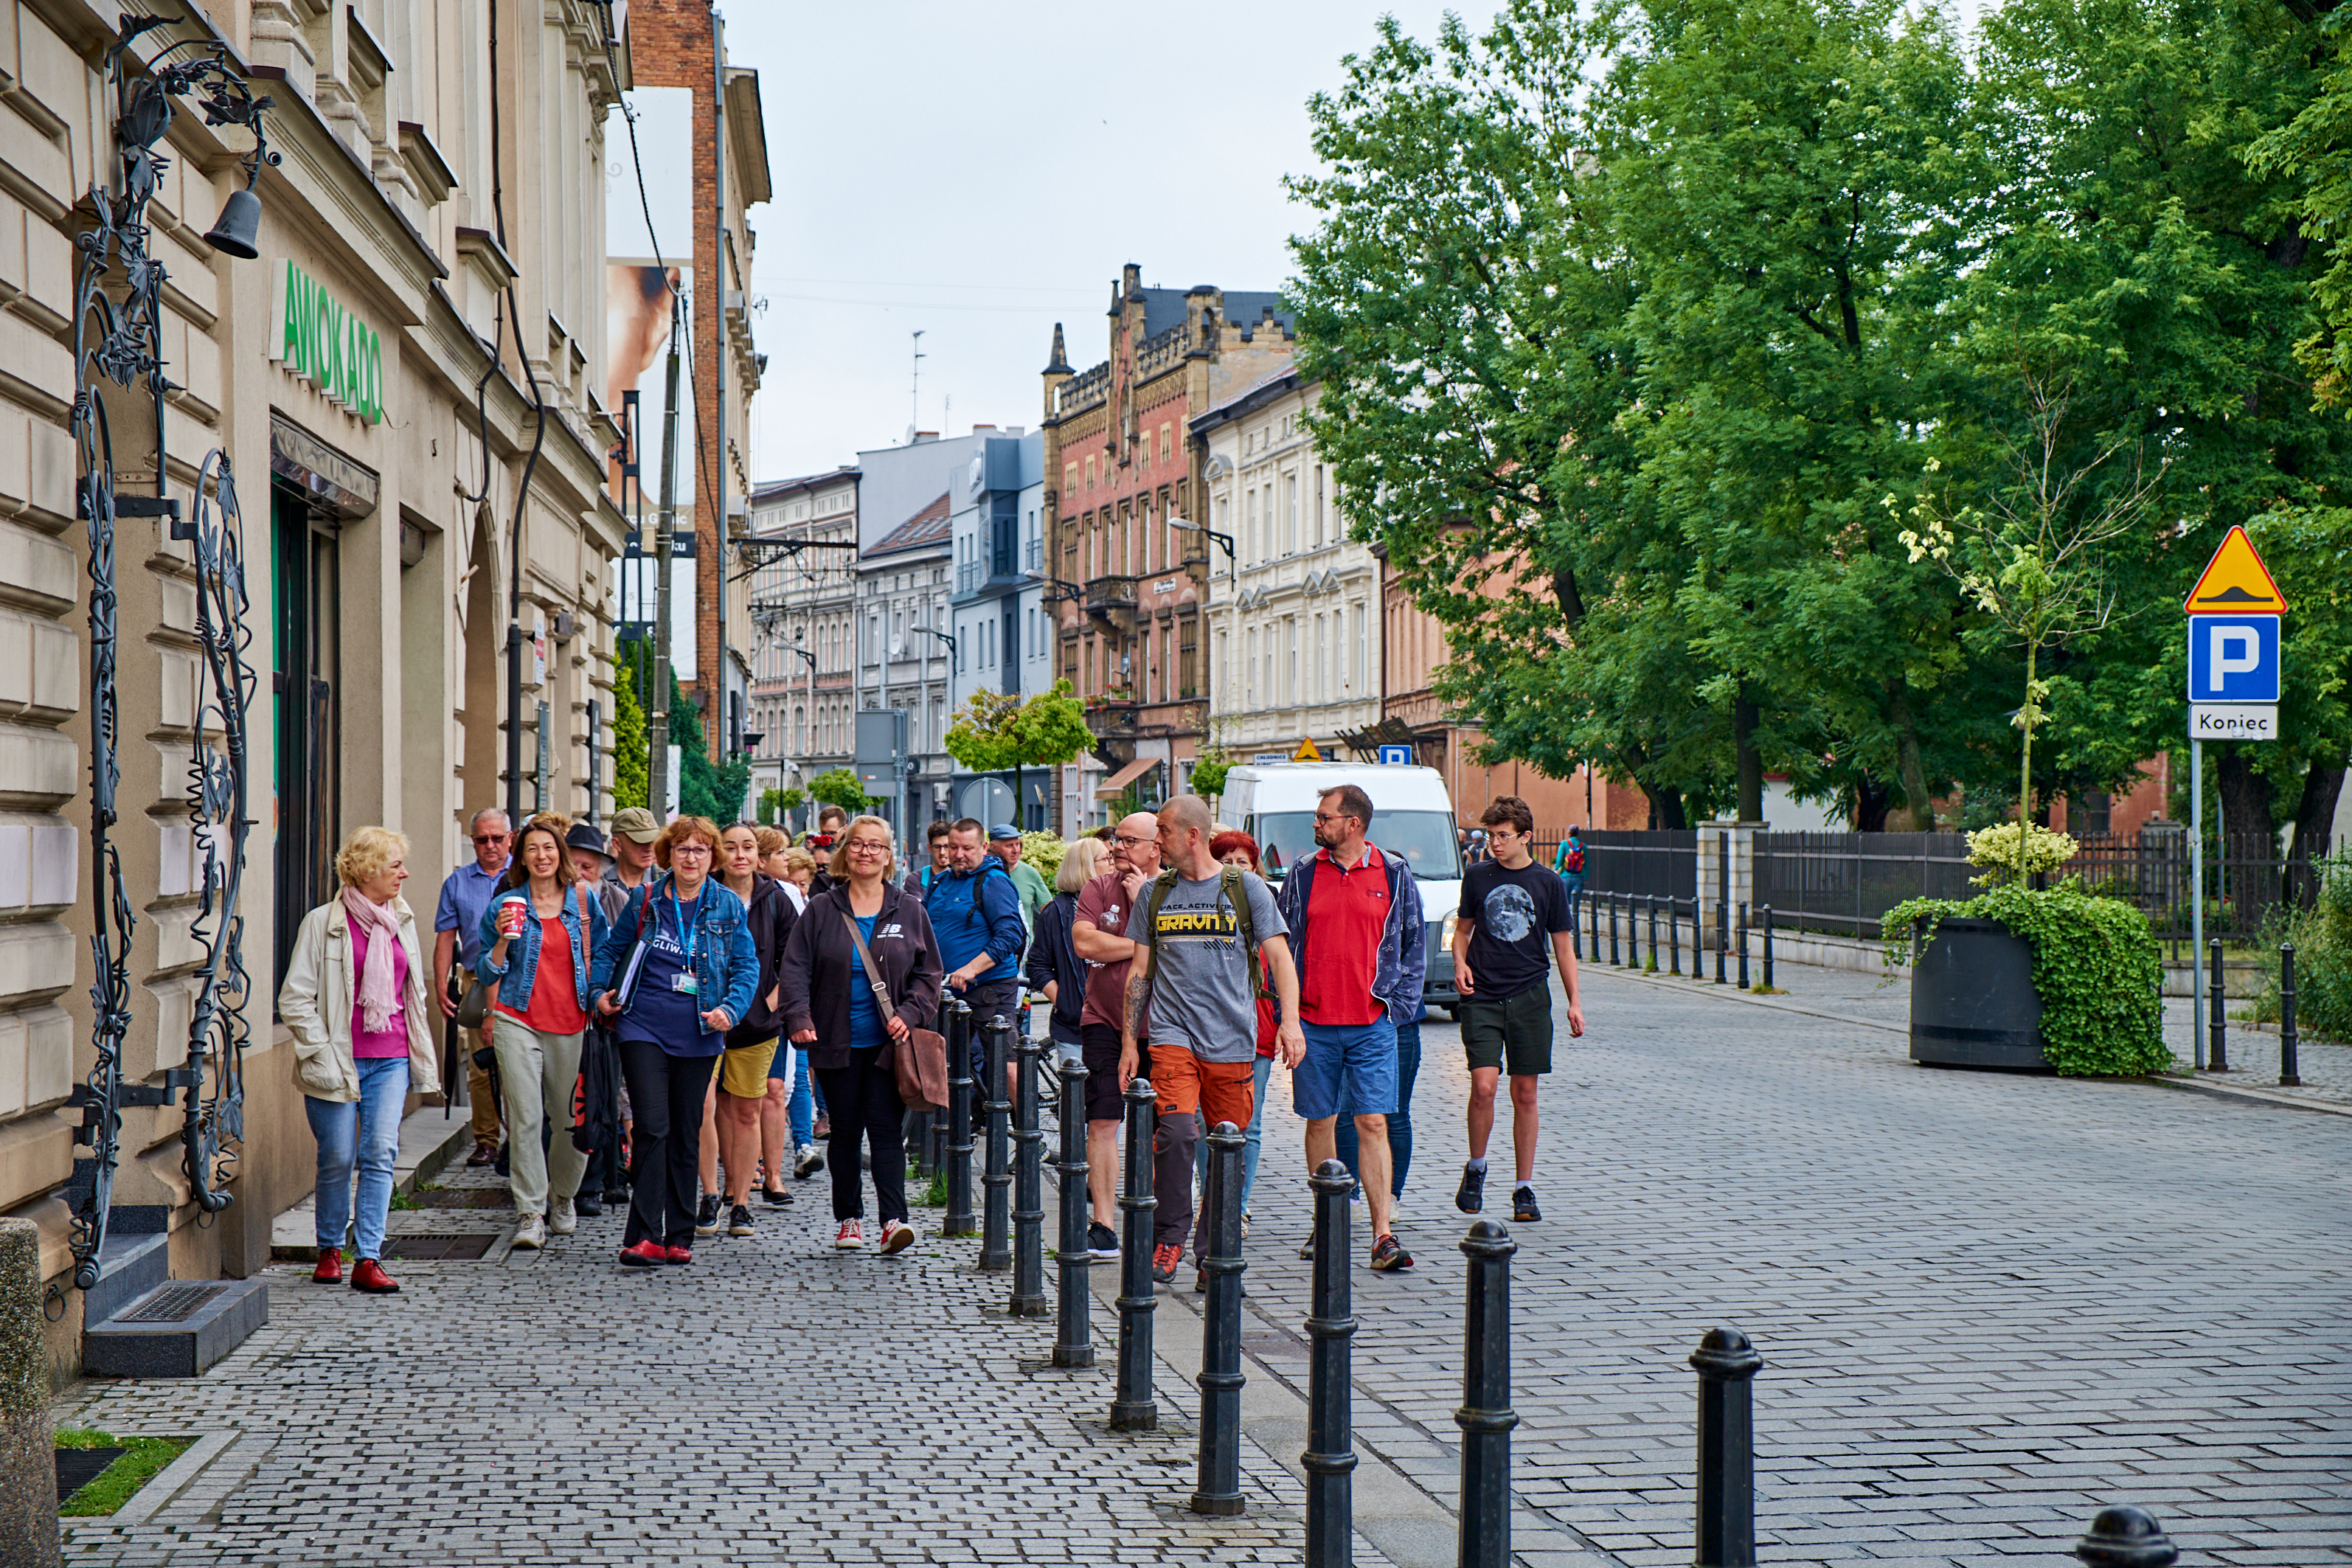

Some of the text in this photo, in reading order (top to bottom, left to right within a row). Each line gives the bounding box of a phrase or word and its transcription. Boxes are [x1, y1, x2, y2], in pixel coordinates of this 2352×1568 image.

[279, 259, 382, 426] AWOKADO
[2210, 625, 2260, 691] P
[2199, 713, 2268, 731] Koniec
